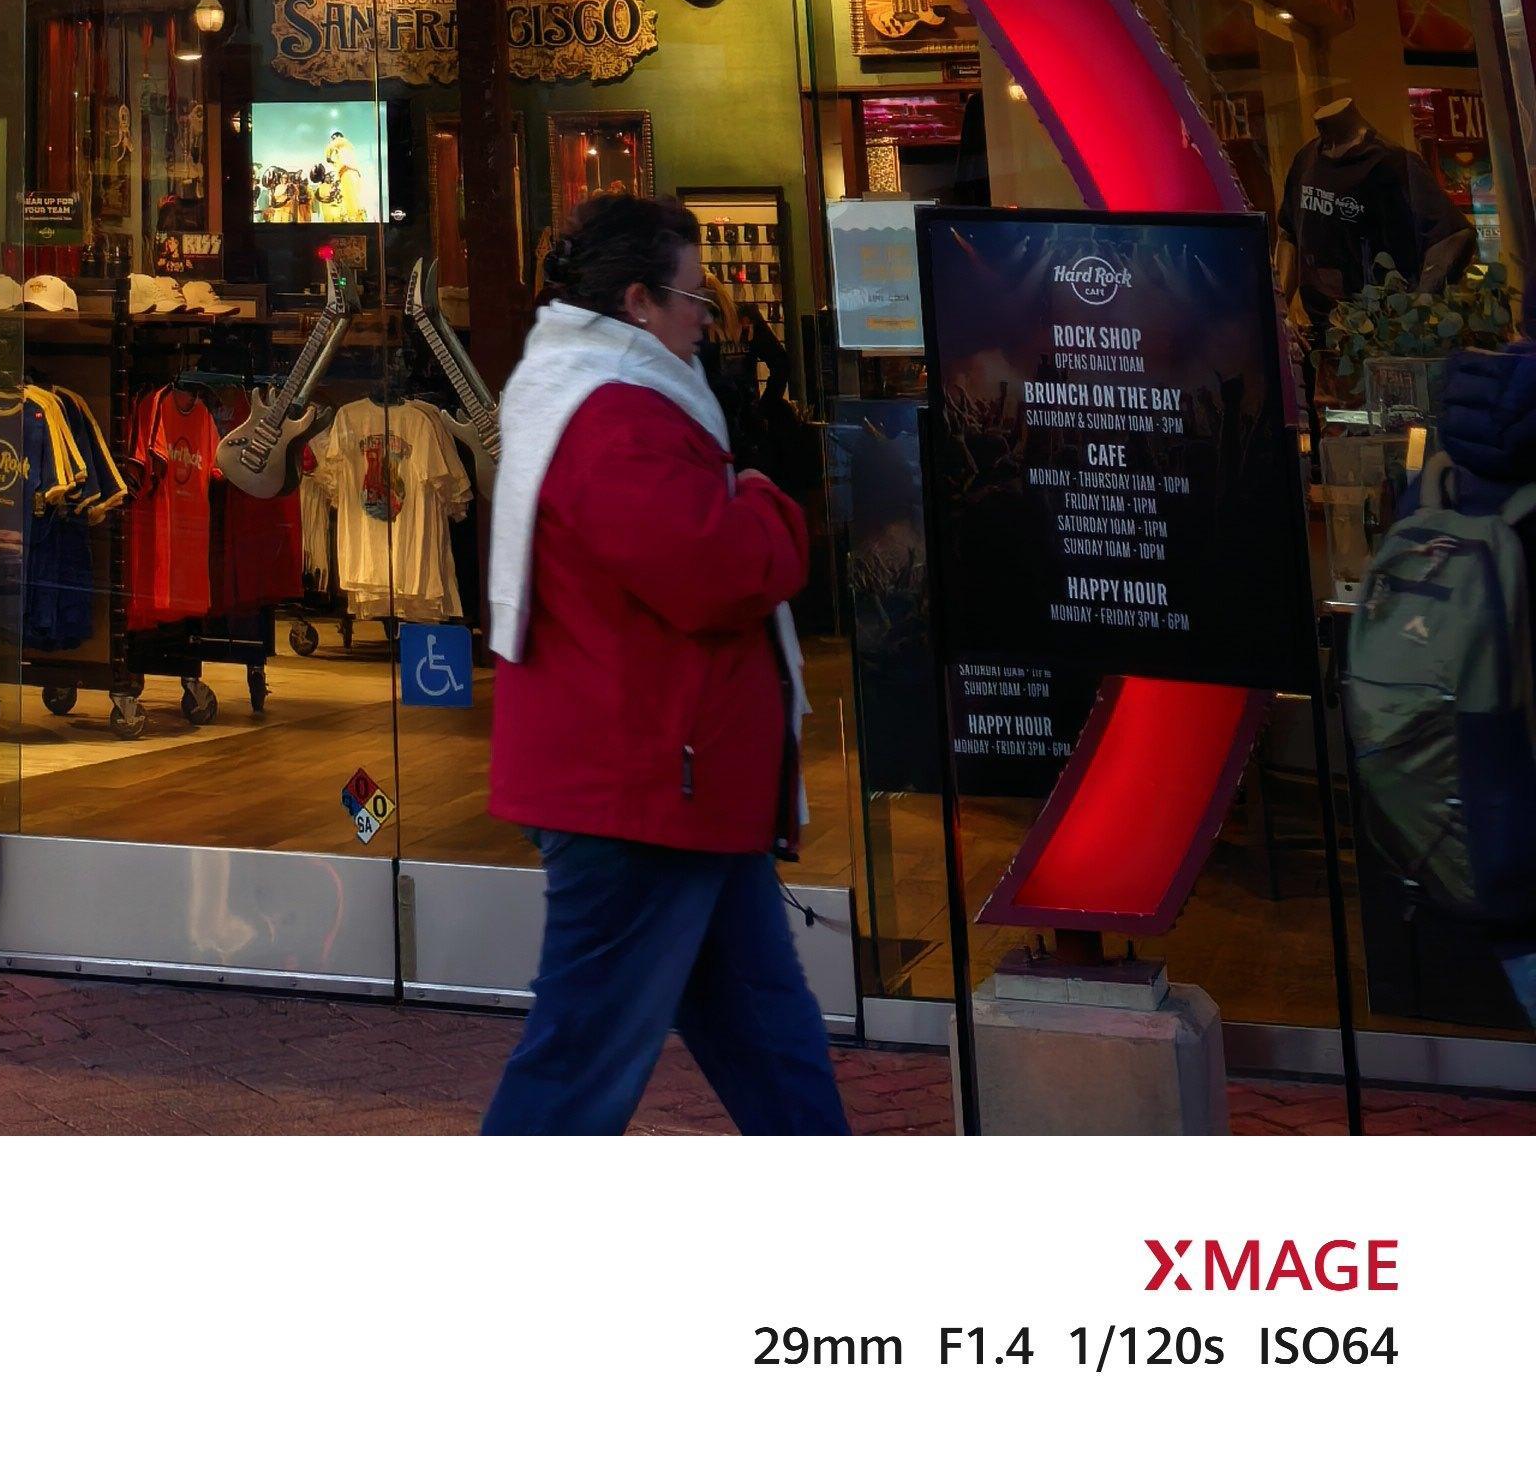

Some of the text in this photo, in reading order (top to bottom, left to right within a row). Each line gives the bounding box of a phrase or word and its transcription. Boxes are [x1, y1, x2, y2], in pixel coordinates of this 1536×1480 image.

[1447, 95, 1483, 138] EXI
[1054, 266, 1133, 287] Hard Rock
[1053, 325, 1142, 350] ROCK SHOP
[1054, 353, 1145, 373] OPENS DAILY 10AM
[1024, 381, 1181, 411] BRUNCH ON THE BAY
[1026, 409, 1077, 428] SATURDAY
[1087, 413, 1125, 431] SUNDAY
[1128, 415, 1154, 432] 10AM
[1161, 418, 1184, 435] 3PM
[1087, 443, 1127, 467] CAFE
[1028, 467, 1071, 486] MONDAY
[1078, 471, 1130, 489] THURSDAY
[1131, 474, 1156, 492] 11AM
[1163, 476, 1190, 495] 10PM
[1064, 492, 1099, 510] FRIDAY
[1101, 495, 1125, 512] 11AM
[1133, 497, 1157, 515] 11PM
[1057, 515, 1108, 534] SATURDAY
[1109, 518, 1135, 536] 10AM
[1143, 520, 1168, 538] 11PM
[1063, 537, 1103, 556] SUNDAY
[1104, 540, 1131, 558] 10AM
[1138, 542, 1165, 561] 10PM
[1067, 576, 1168, 606] HAPPY HOUR
[1050, 604, 1092, 623] MONDAY
[1100, 607, 1135, 627] FRIDAY
[1137, 610, 1160, 629] 3PM
[1167, 612, 1190, 631] 6PM
[964, 681, 998, 696] SUNDAY
[999, 682, 1021, 696] 10AM
[1027, 683, 1050, 698] 10PM
[968, 714, 1053, 737] HAPPY HOUR
[954, 738, 990, 755] MONDAY
[996, 740, 1026, 756] FRIDAY
[1027, 742, 1047, 757] 3PM
[1052, 742, 1072, 757] 6PM
[373, 794, 387, 818] 0
